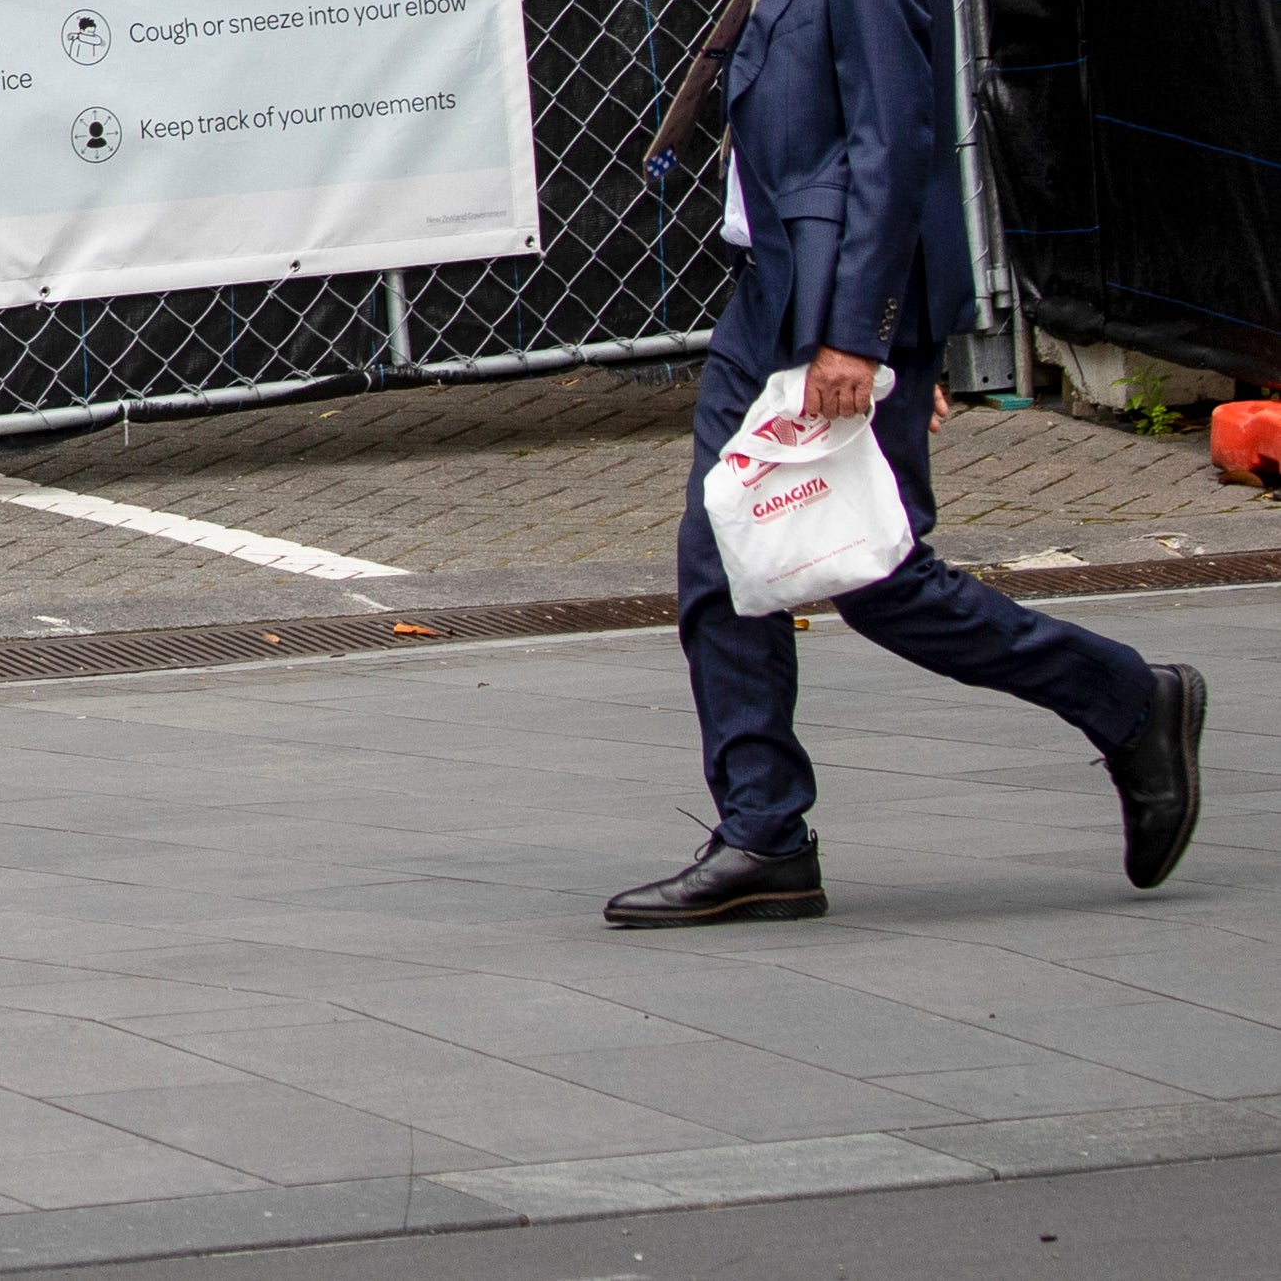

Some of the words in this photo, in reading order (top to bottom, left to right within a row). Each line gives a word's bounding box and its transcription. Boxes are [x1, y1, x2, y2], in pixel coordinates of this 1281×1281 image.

[130, 18, 197, 45] Cough
[203, 20, 224, 36] or
[229, 13, 303, 33] sneeze
[309, 6, 349, 25] into
[354, 3, 400, 26] your
[141, 119, 193, 140] Keep
[198, 110, 249, 133] track
[254, 106, 274, 128] of
[278, 107, 326, 130] your
[331, 92, 456, 120] movements
[753, 477, 828, 517] GARAGISTA
